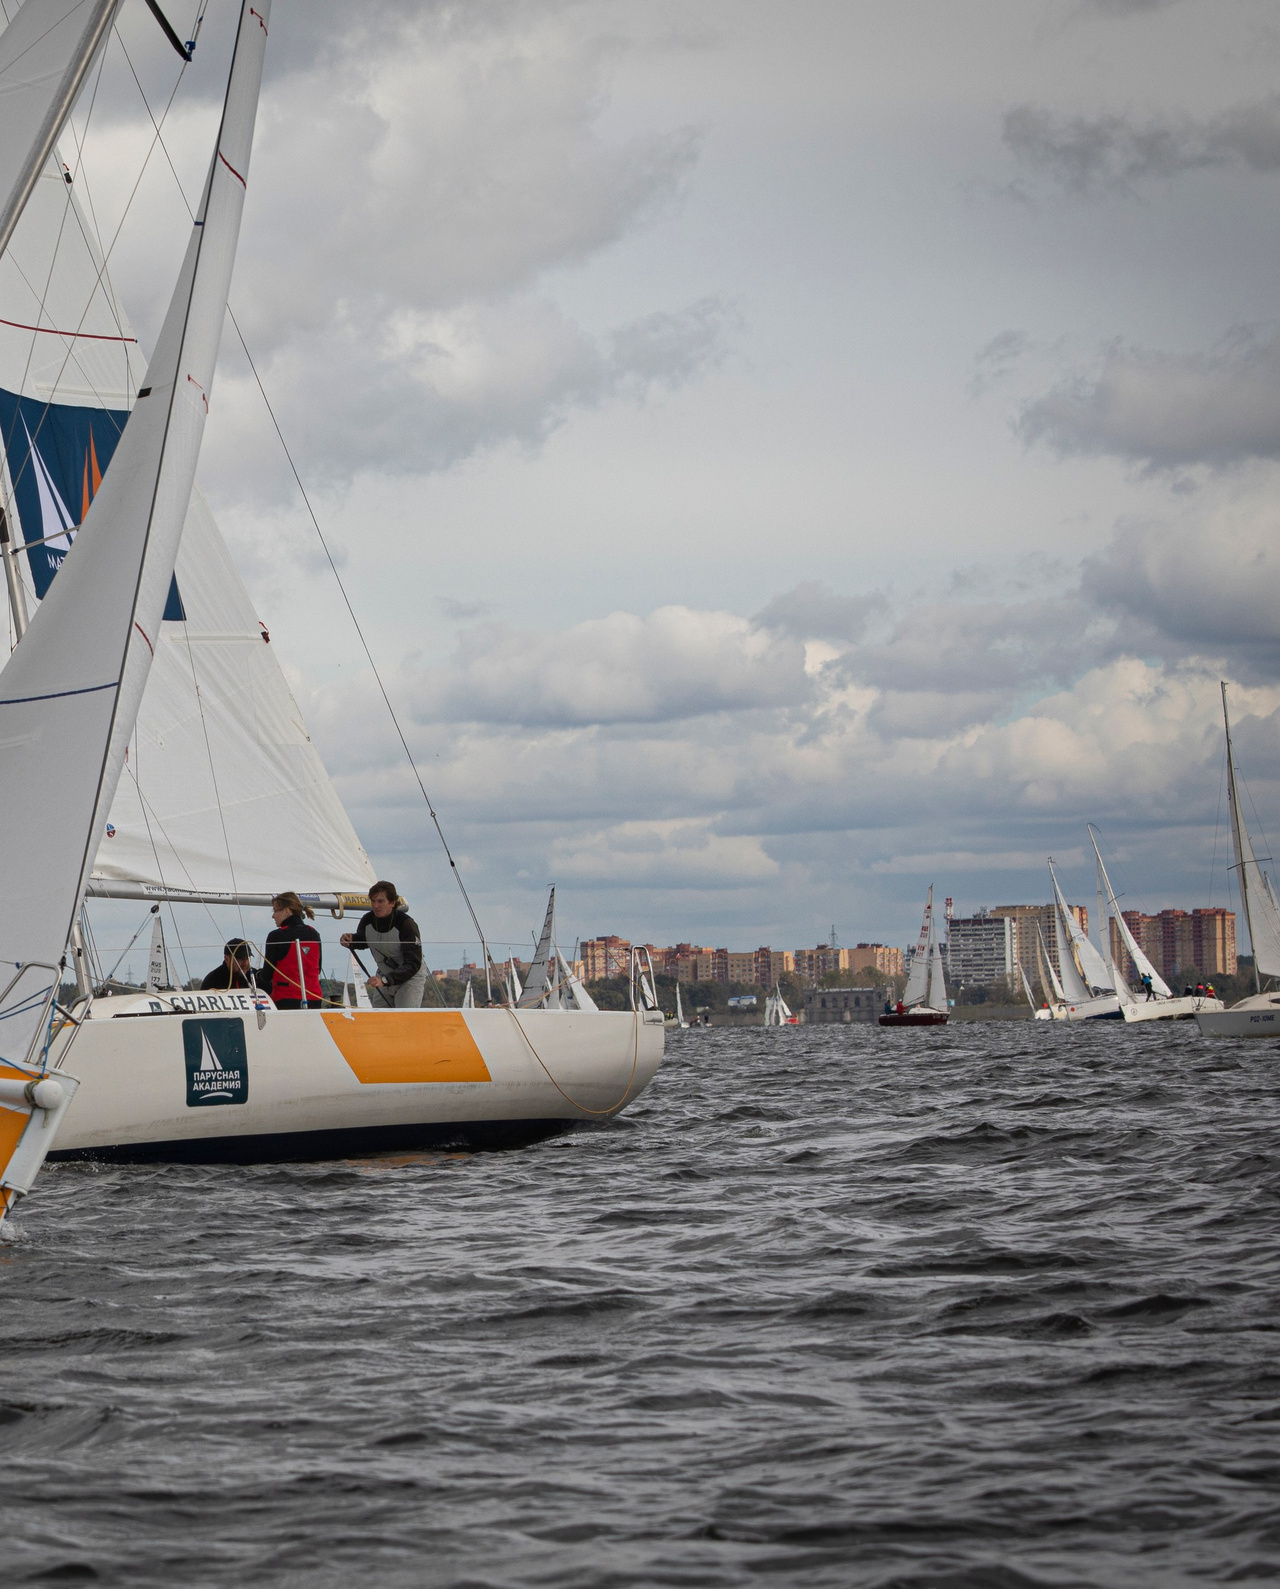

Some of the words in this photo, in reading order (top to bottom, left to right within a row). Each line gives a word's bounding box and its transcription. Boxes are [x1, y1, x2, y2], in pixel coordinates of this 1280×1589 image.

[170, 995, 250, 1011] CHARLIE
[193, 1070, 241, 1081] ПАРУСНАЯ
[192, 1080, 241, 1091] АКАДЕМИЯ
